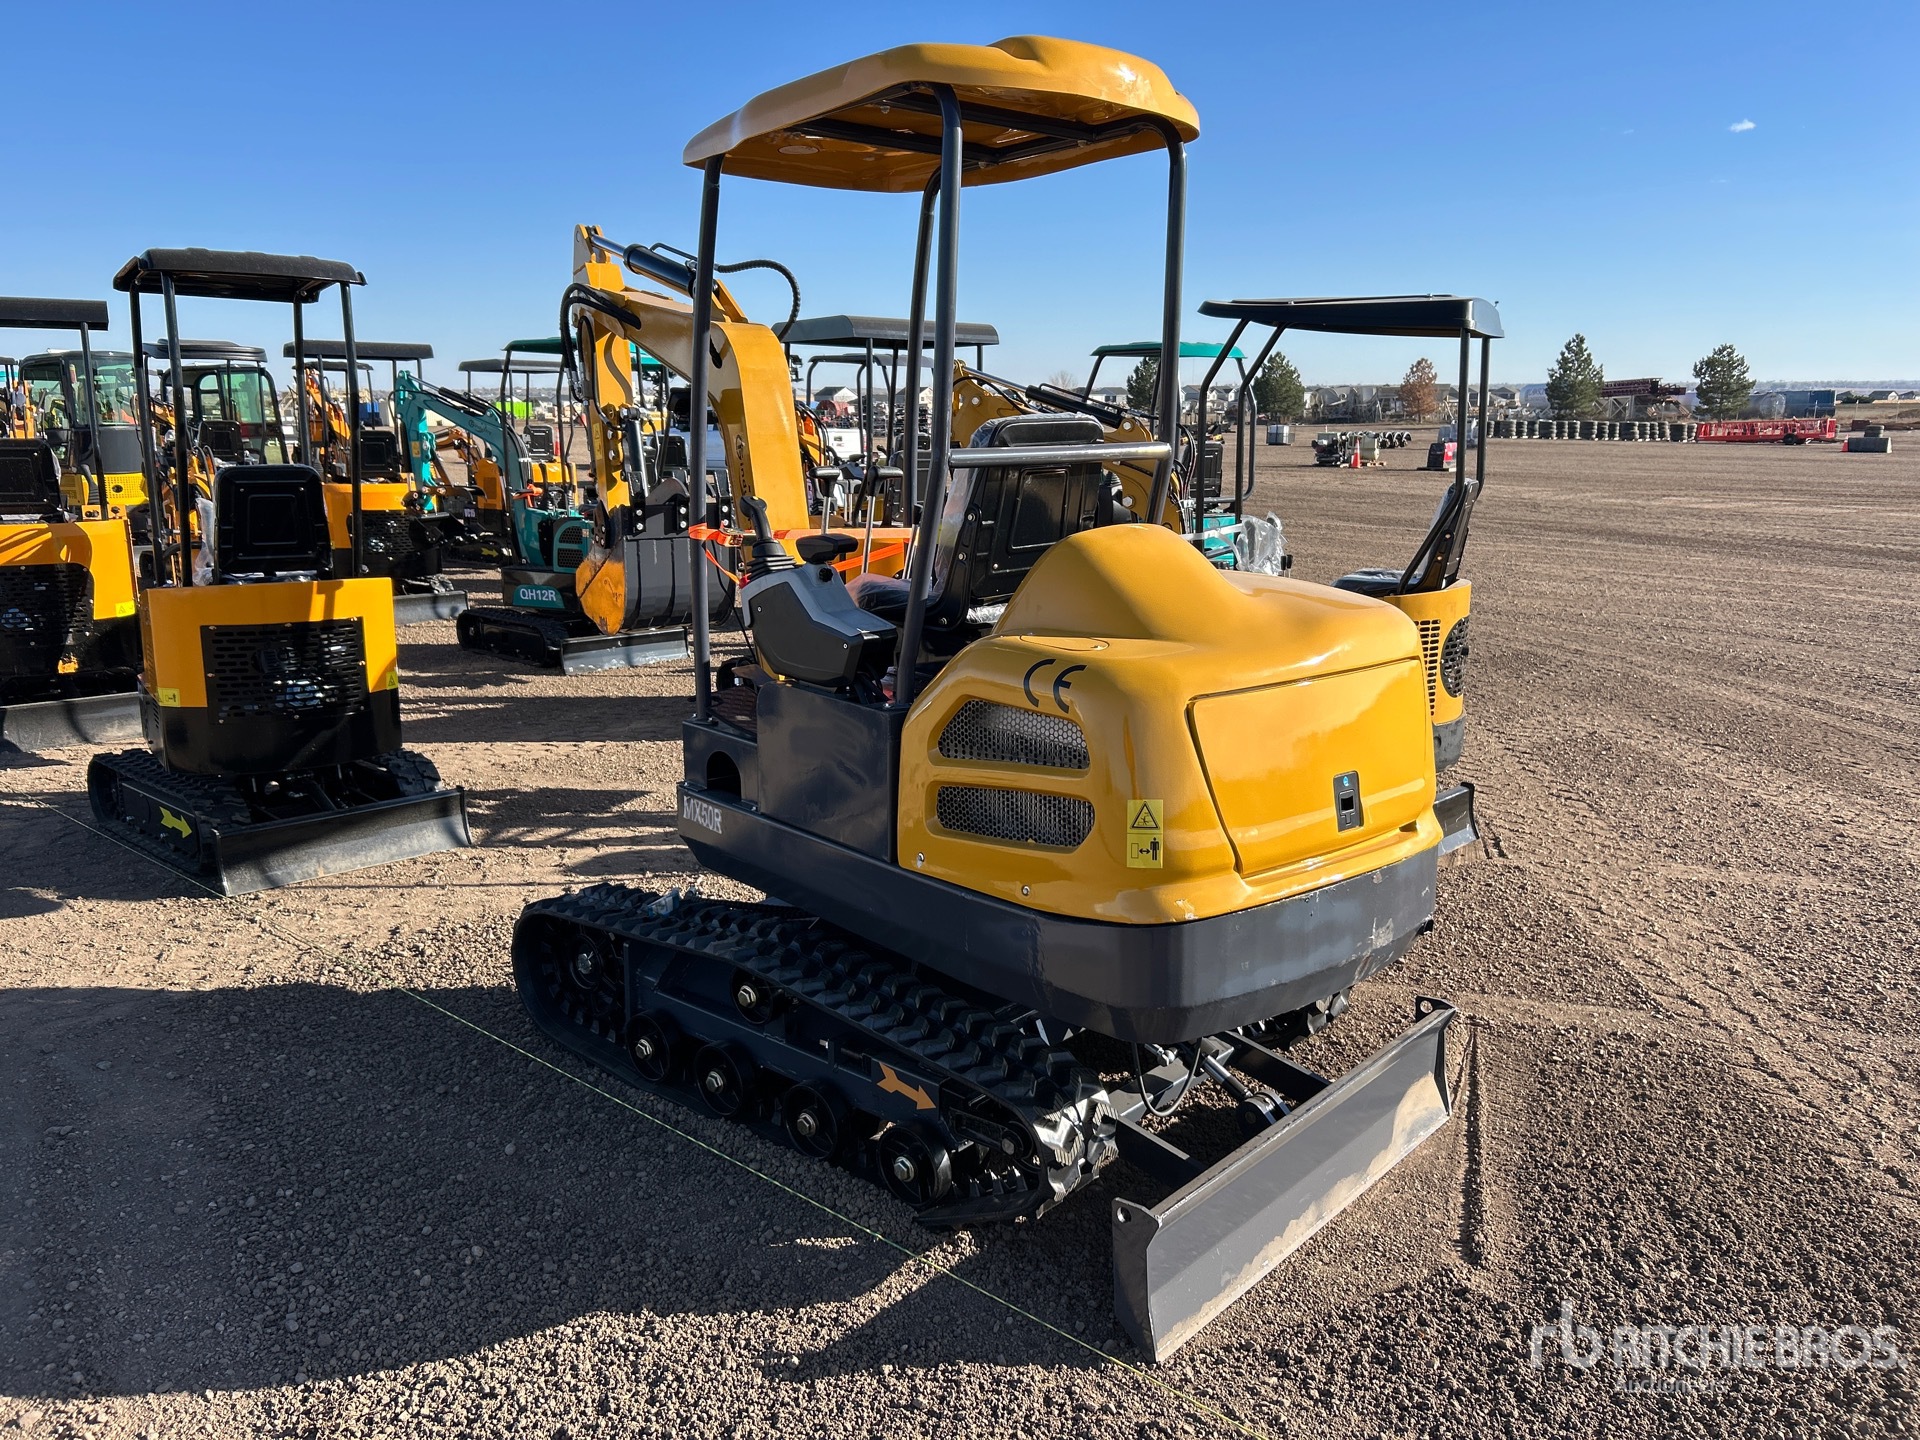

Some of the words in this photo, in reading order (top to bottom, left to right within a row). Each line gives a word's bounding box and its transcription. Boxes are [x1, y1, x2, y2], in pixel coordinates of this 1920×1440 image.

[520, 588, 556, 601] QH12R
[1023, 658, 1087, 714] CE
[683, 796, 722, 834] MX50R
